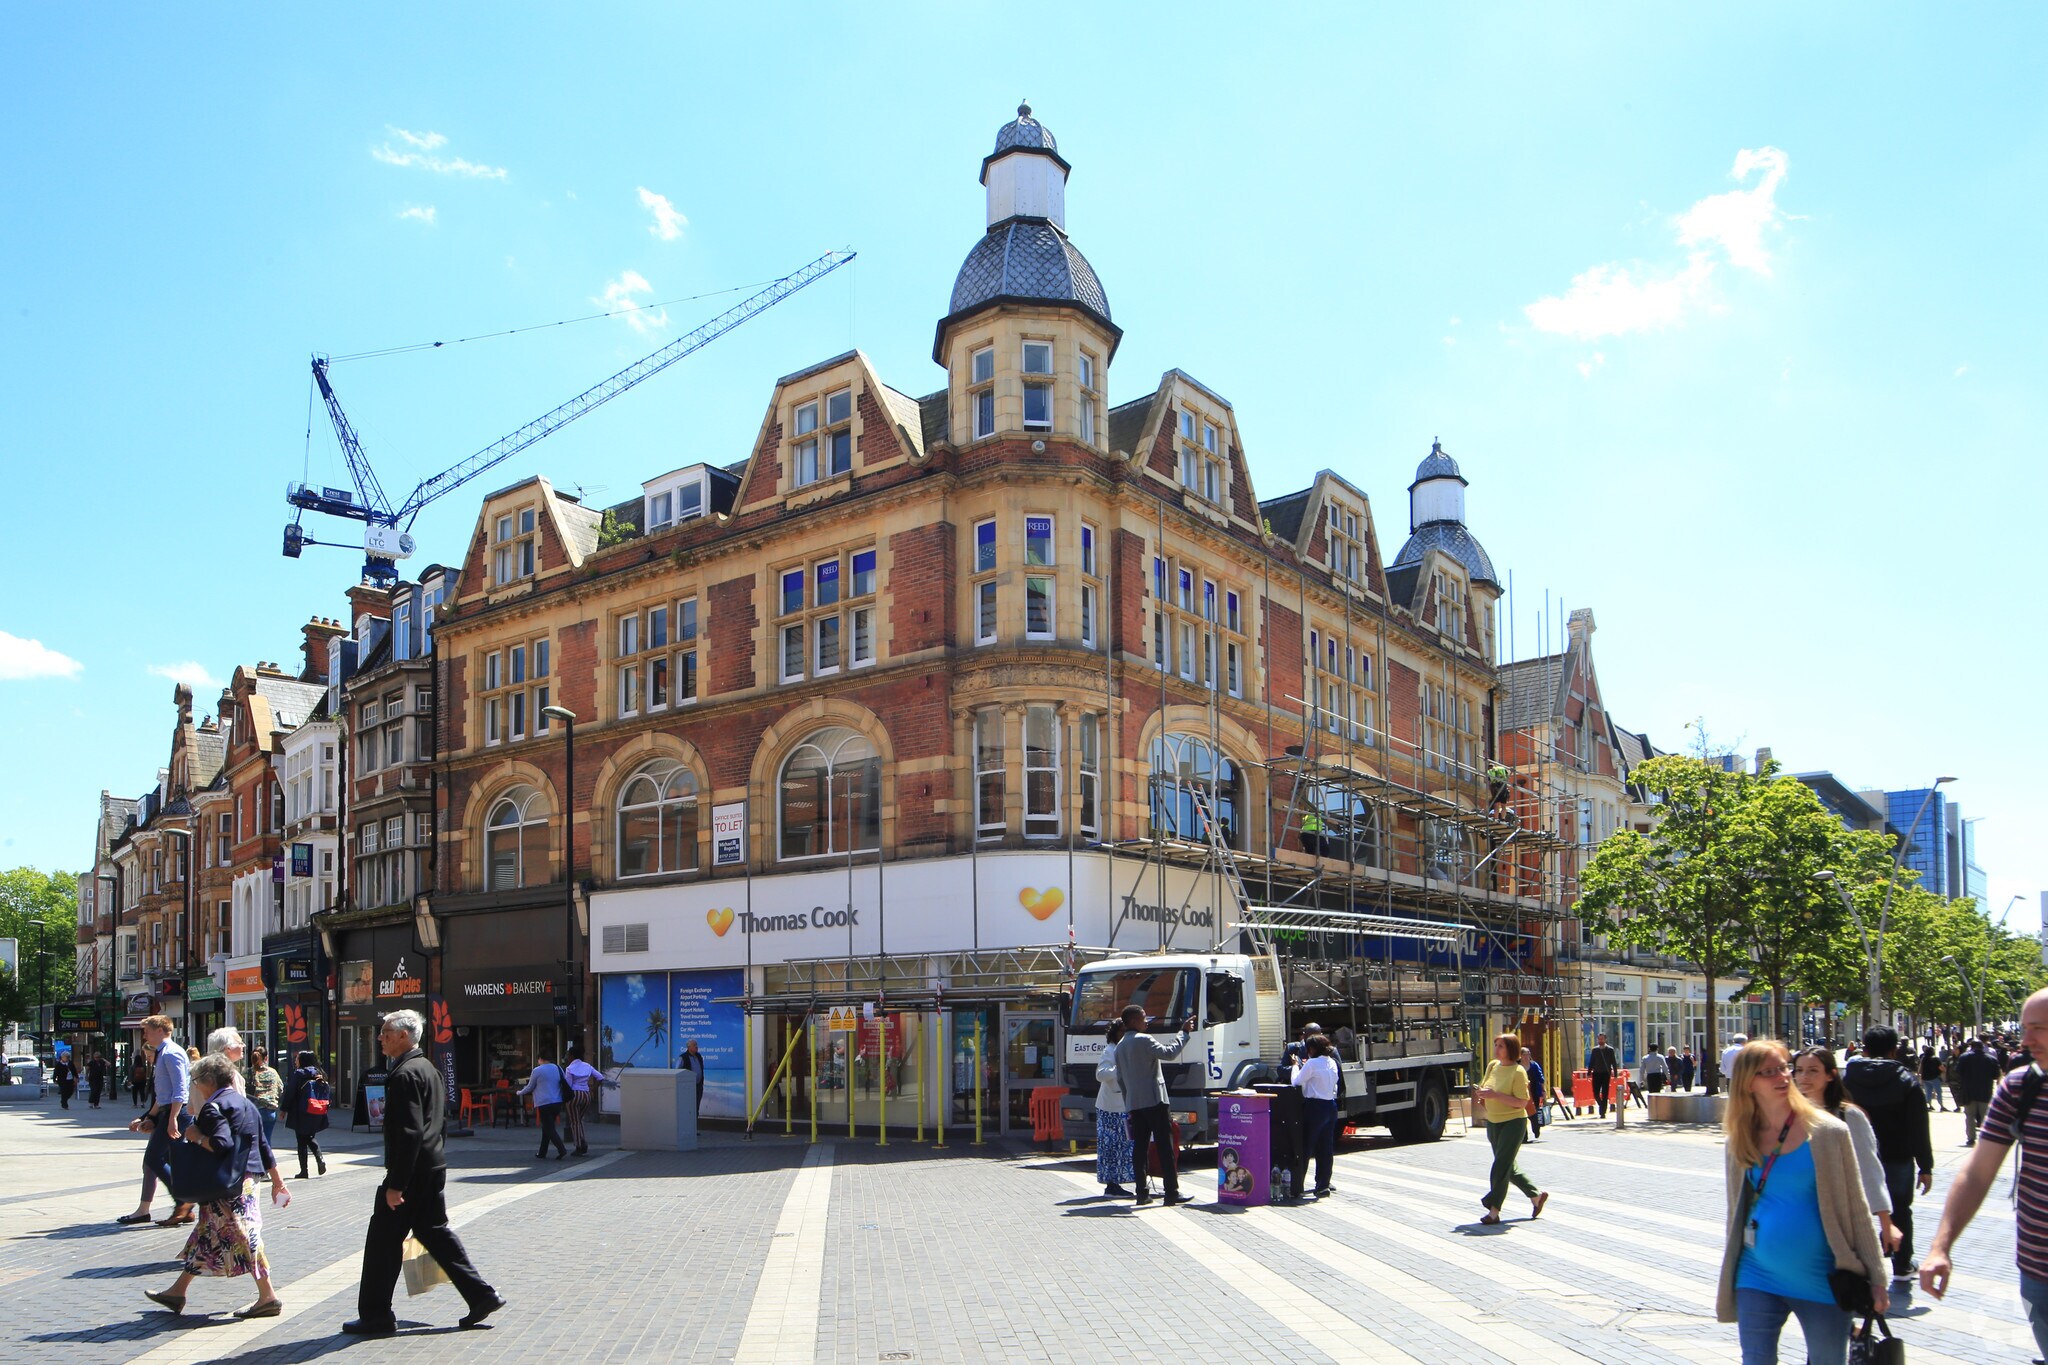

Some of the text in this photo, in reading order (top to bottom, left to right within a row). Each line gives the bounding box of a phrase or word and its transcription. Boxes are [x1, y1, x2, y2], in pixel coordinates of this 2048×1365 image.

[1028, 522, 1050, 531] REED
[369, 537, 385, 548] LTC
[822, 564, 838, 576] REED
[715, 820, 743, 833] TO LET
[1122, 895, 1214, 928] Thomas Cook
[738, 904, 859, 934] Thomas Cook
[290, 970, 308, 978] HILL
[464, 983, 505, 996] WARRENS
[512, 981, 547, 994] BAKERY
[61, 1021, 71, 1029] 24
[80, 1020, 98, 1029] TAXI
[1074, 1043, 1090, 1052] EAST
[1233, 1134, 1248, 1142] charity
